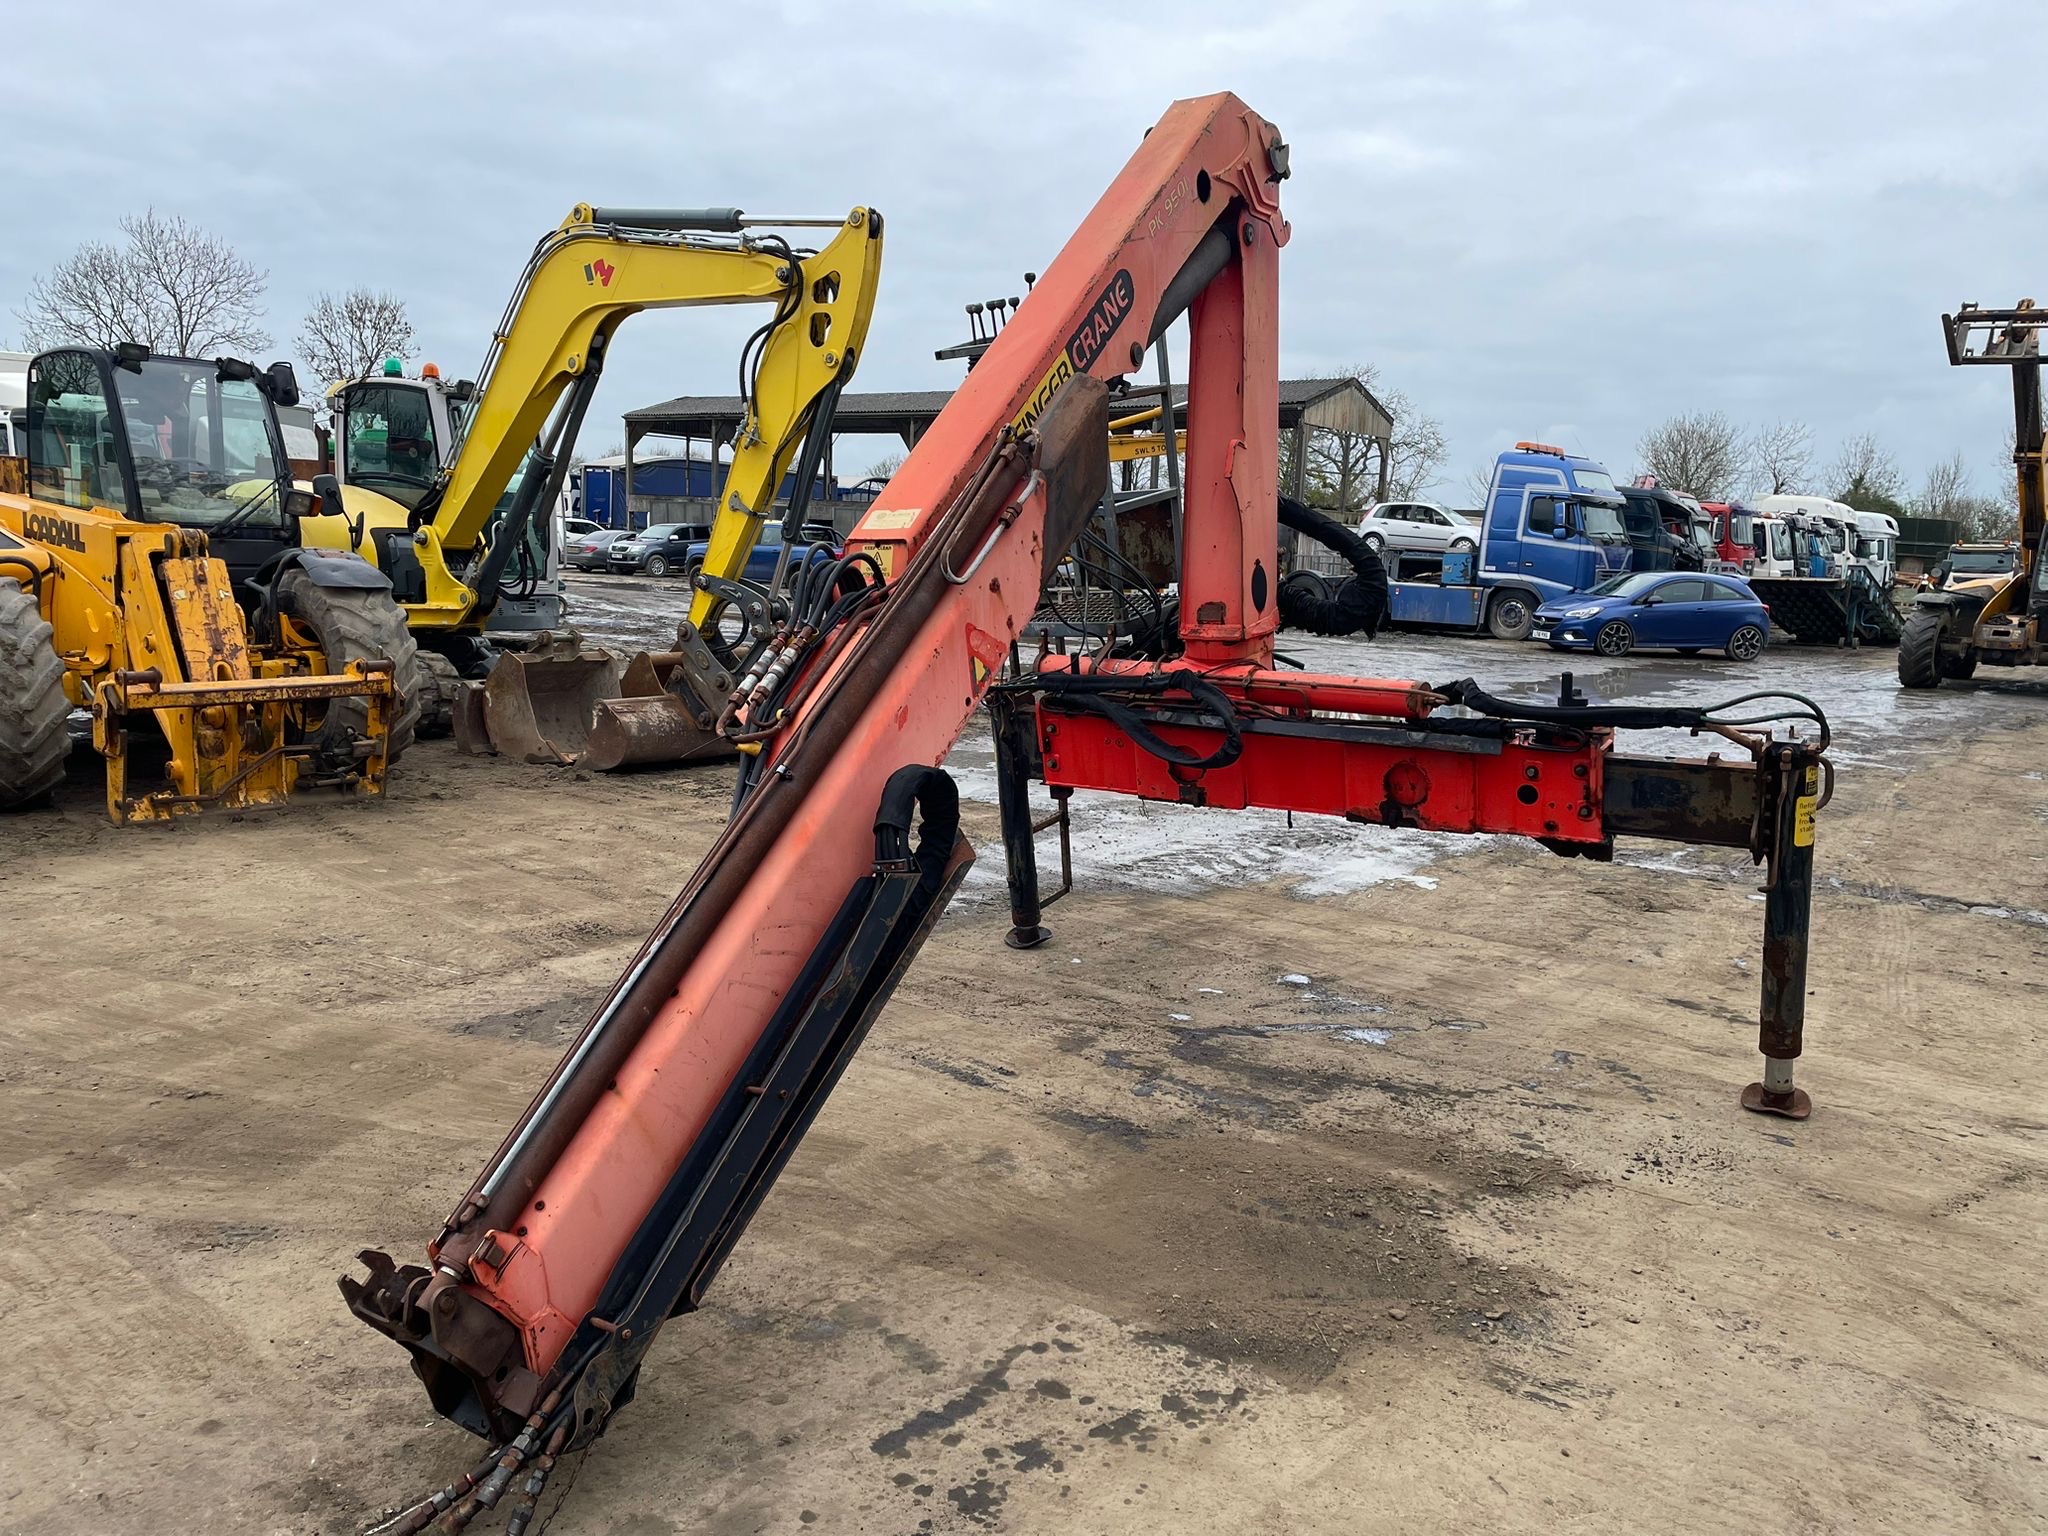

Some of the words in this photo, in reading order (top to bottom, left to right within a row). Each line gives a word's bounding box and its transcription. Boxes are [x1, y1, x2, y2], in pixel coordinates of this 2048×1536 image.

[1148, 210, 1164, 238] PK
[1072, 278, 1129, 369] CRANE
[22, 511, 86, 553] LOADALL
